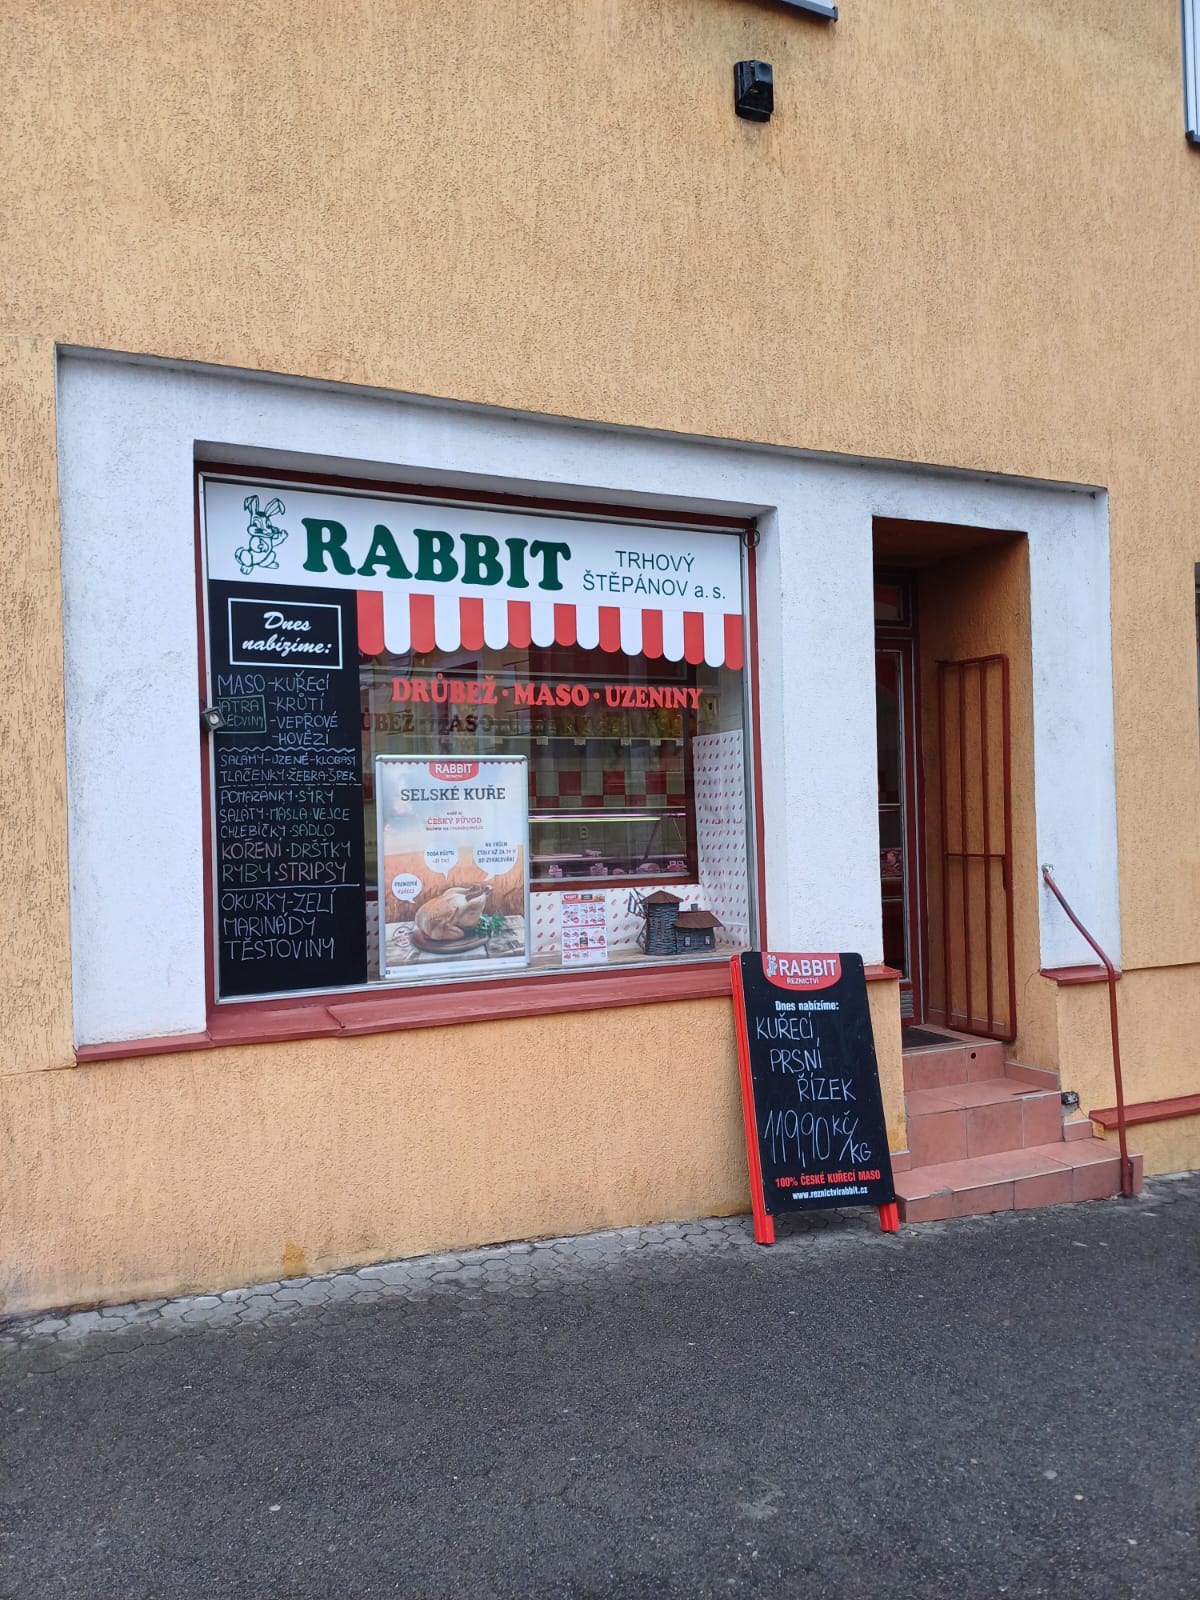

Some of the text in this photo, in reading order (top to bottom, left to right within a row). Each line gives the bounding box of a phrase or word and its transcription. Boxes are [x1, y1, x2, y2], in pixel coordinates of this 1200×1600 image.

[301, 517, 571, 592] RABBIT
[616, 550, 695, 573] TRHOVÝ
[583, 569, 688, 597] ŠTĚPÁNOV
[264, 611, 311, 631] Dnes
[242, 634, 332, 657] nabízíme:
[217, 674, 266, 696] MASO
[392, 673, 703, 709] DRŮBEŽ MASO UZENINY
[226, 715, 264, 728] EDVINY
[435, 763, 473, 774] RABBIT
[400, 784, 506, 801] SELSKÉ KUŘE
[222, 861, 347, 884] RYBY STRIPSY
[221, 888, 336, 915] OKURKY ZELÍ
[223, 912, 316, 937] MARINÁDY
[223, 936, 335, 961] TĚSTOVINY
[778, 959, 836, 976] RABBIT
[775, 1000, 840, 1011] Dnes nabízíme:
[755, 1012, 814, 1041] KUŘECÍ
[770, 1036, 823, 1074] PRSNÍ
[797, 1073, 857, 1102] ŘÍZEK
[776, 1169, 881, 1189] 100% ČESKÉ KUŘECÍ MASO
[792, 1186, 869, 1200] www.reznictvirabbit.cz
